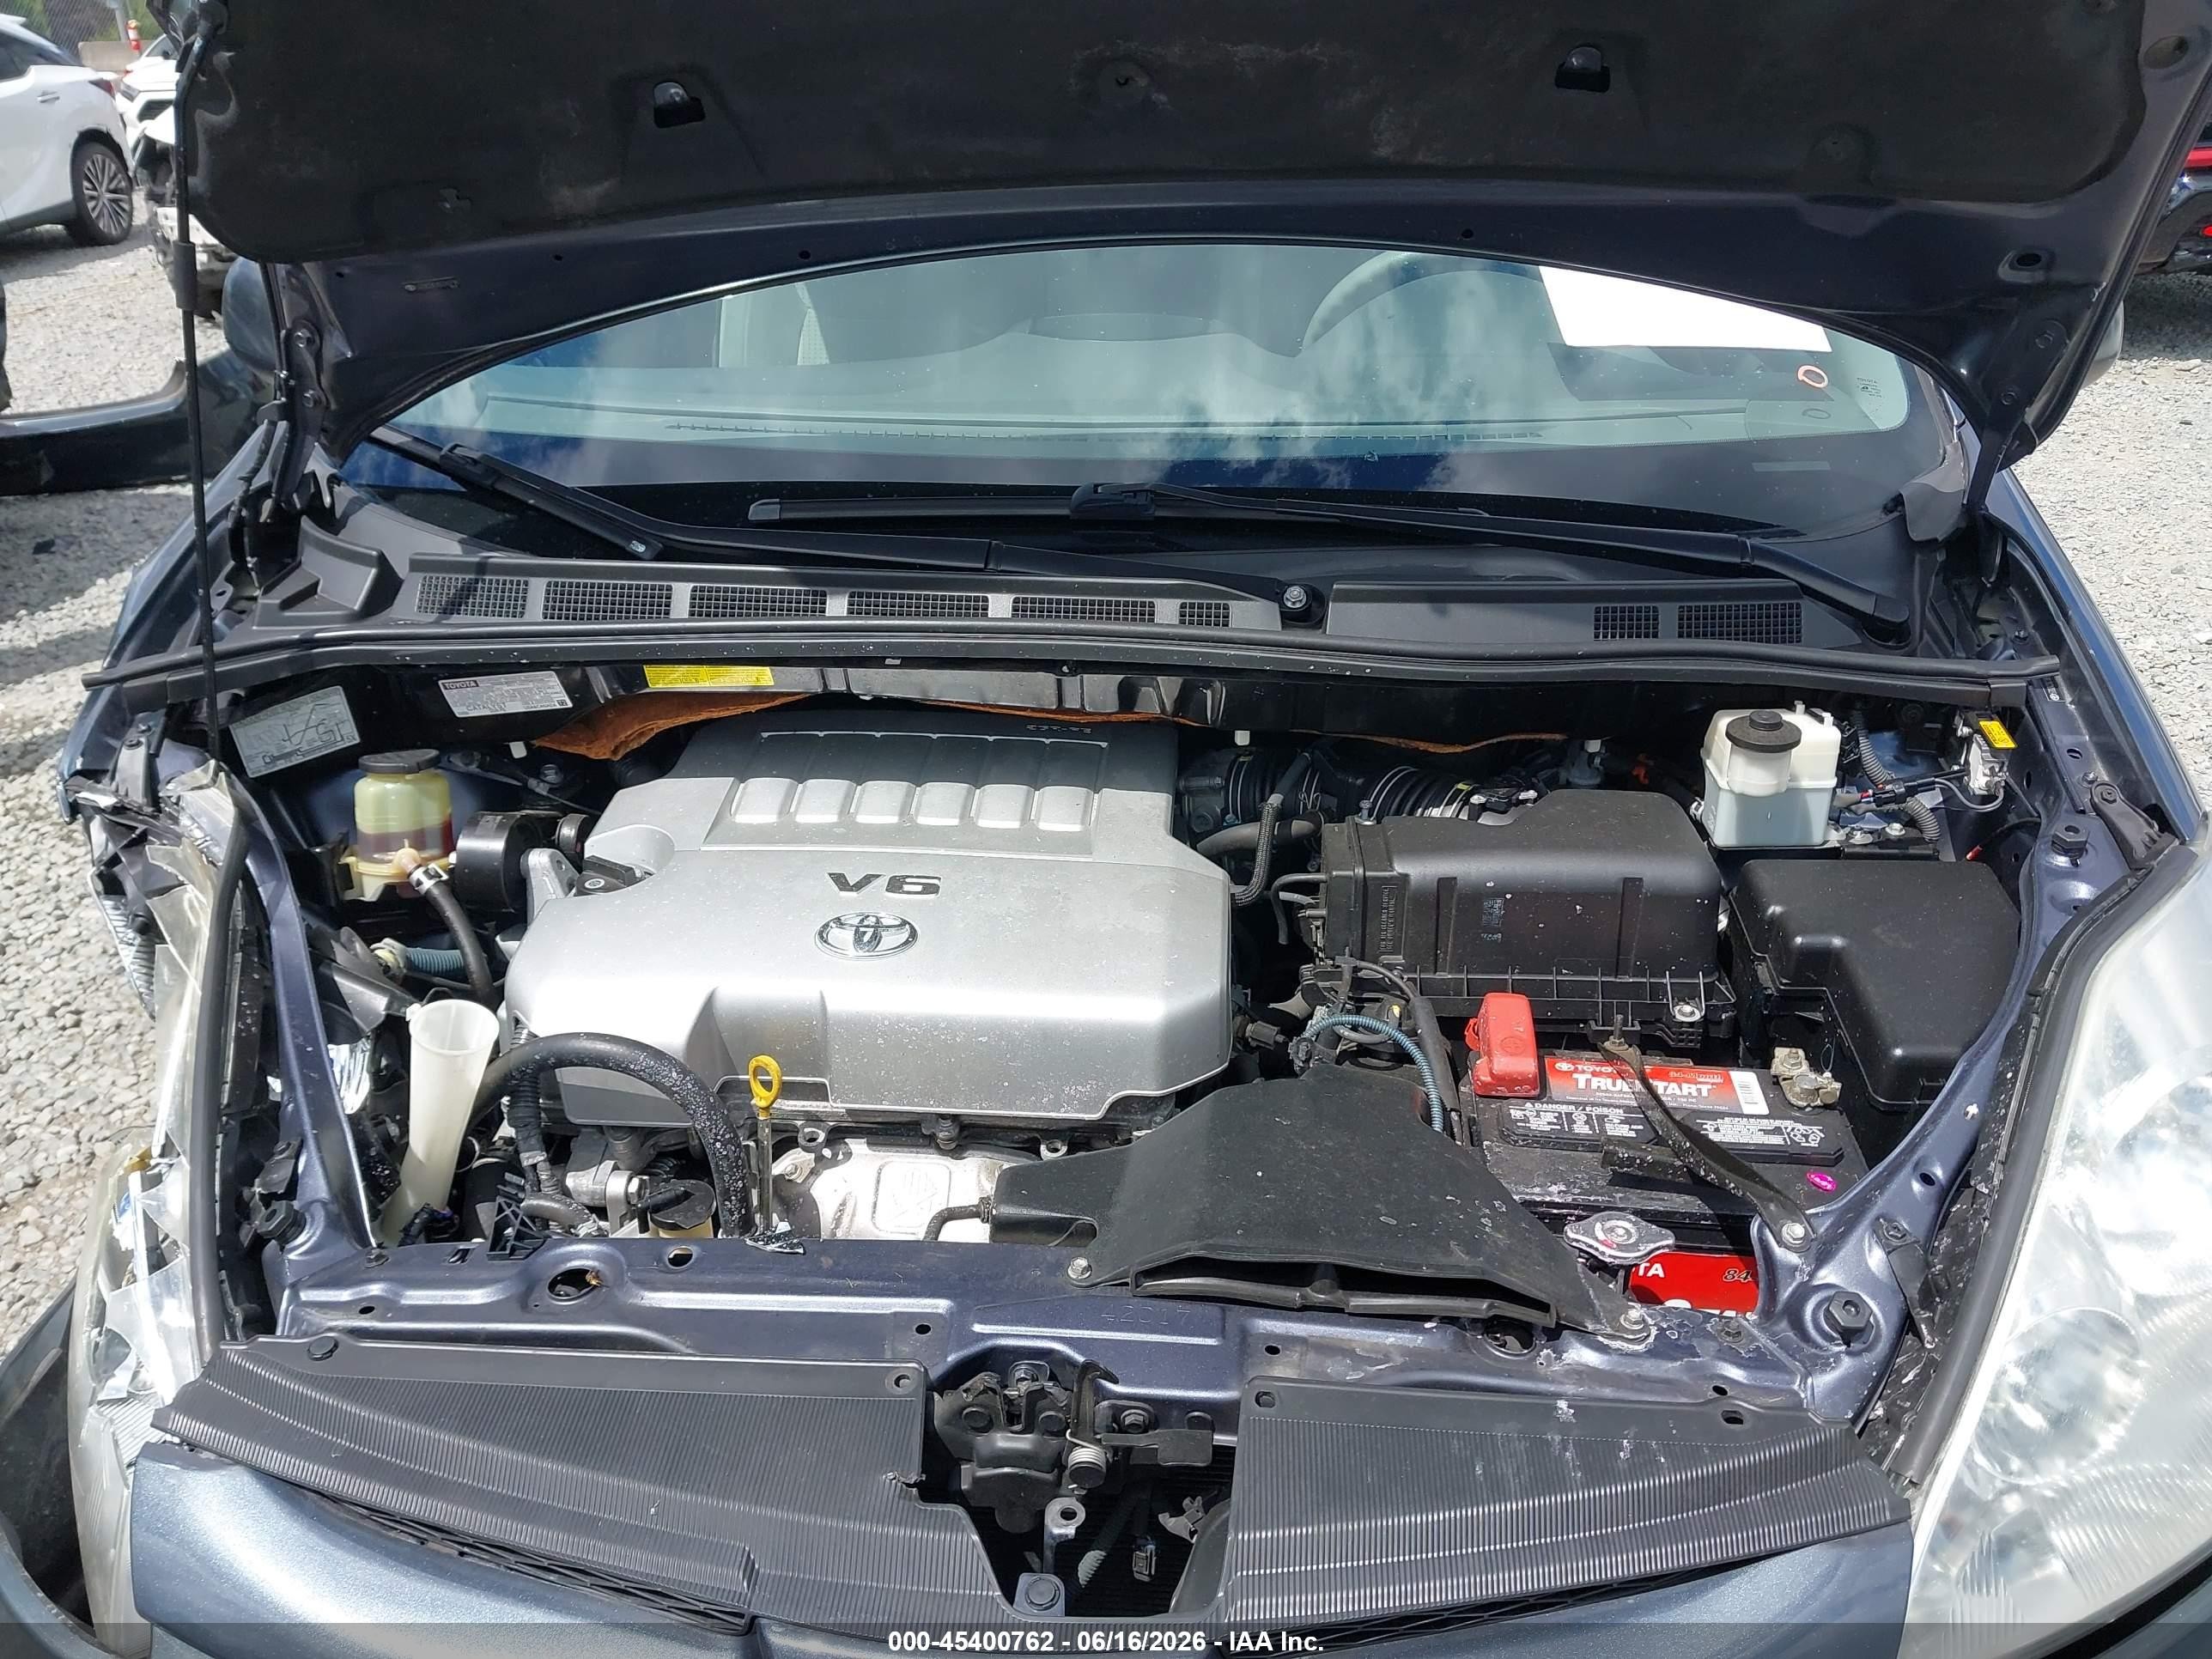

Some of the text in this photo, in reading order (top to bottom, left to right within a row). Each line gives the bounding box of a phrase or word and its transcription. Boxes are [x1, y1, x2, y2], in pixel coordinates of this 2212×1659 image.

[828, 872, 942, 896] V6
[1534, 1103, 1577, 1111] DANGER
[1586, 1106, 1623, 1115] POISON
[1632, 1262, 1666, 1279] TA
